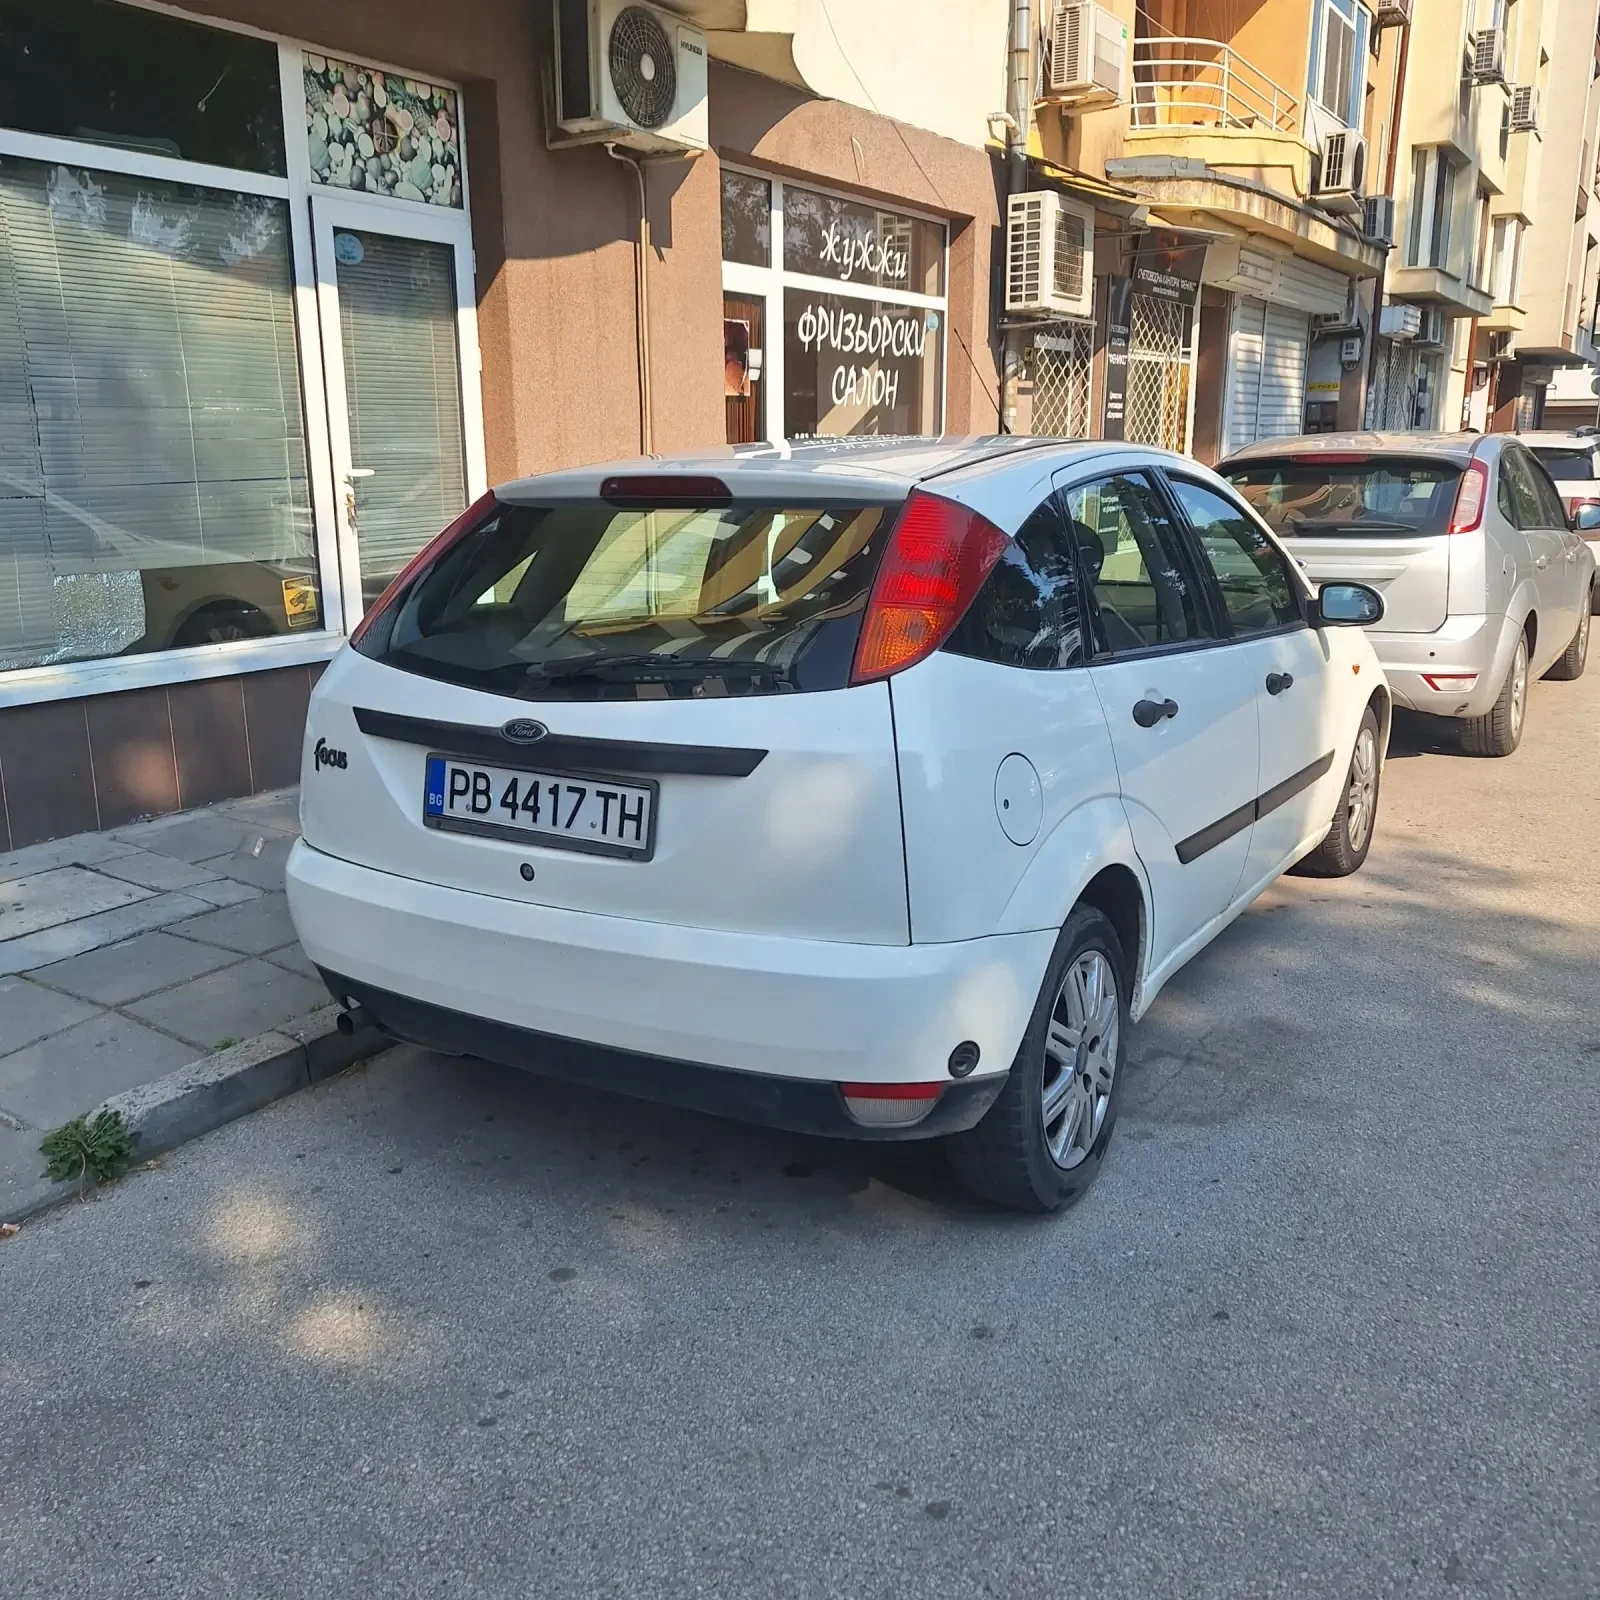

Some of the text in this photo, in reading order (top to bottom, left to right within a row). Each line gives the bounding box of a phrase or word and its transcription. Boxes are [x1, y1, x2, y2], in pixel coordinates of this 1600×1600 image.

[798, 304, 927, 358] ФРИЗЬОРСКИ
[832, 364, 899, 410] САЛОН
[510, 723, 536, 737] Ford
[429, 792, 443, 806] BG
[500, 777, 587, 829] 4417
